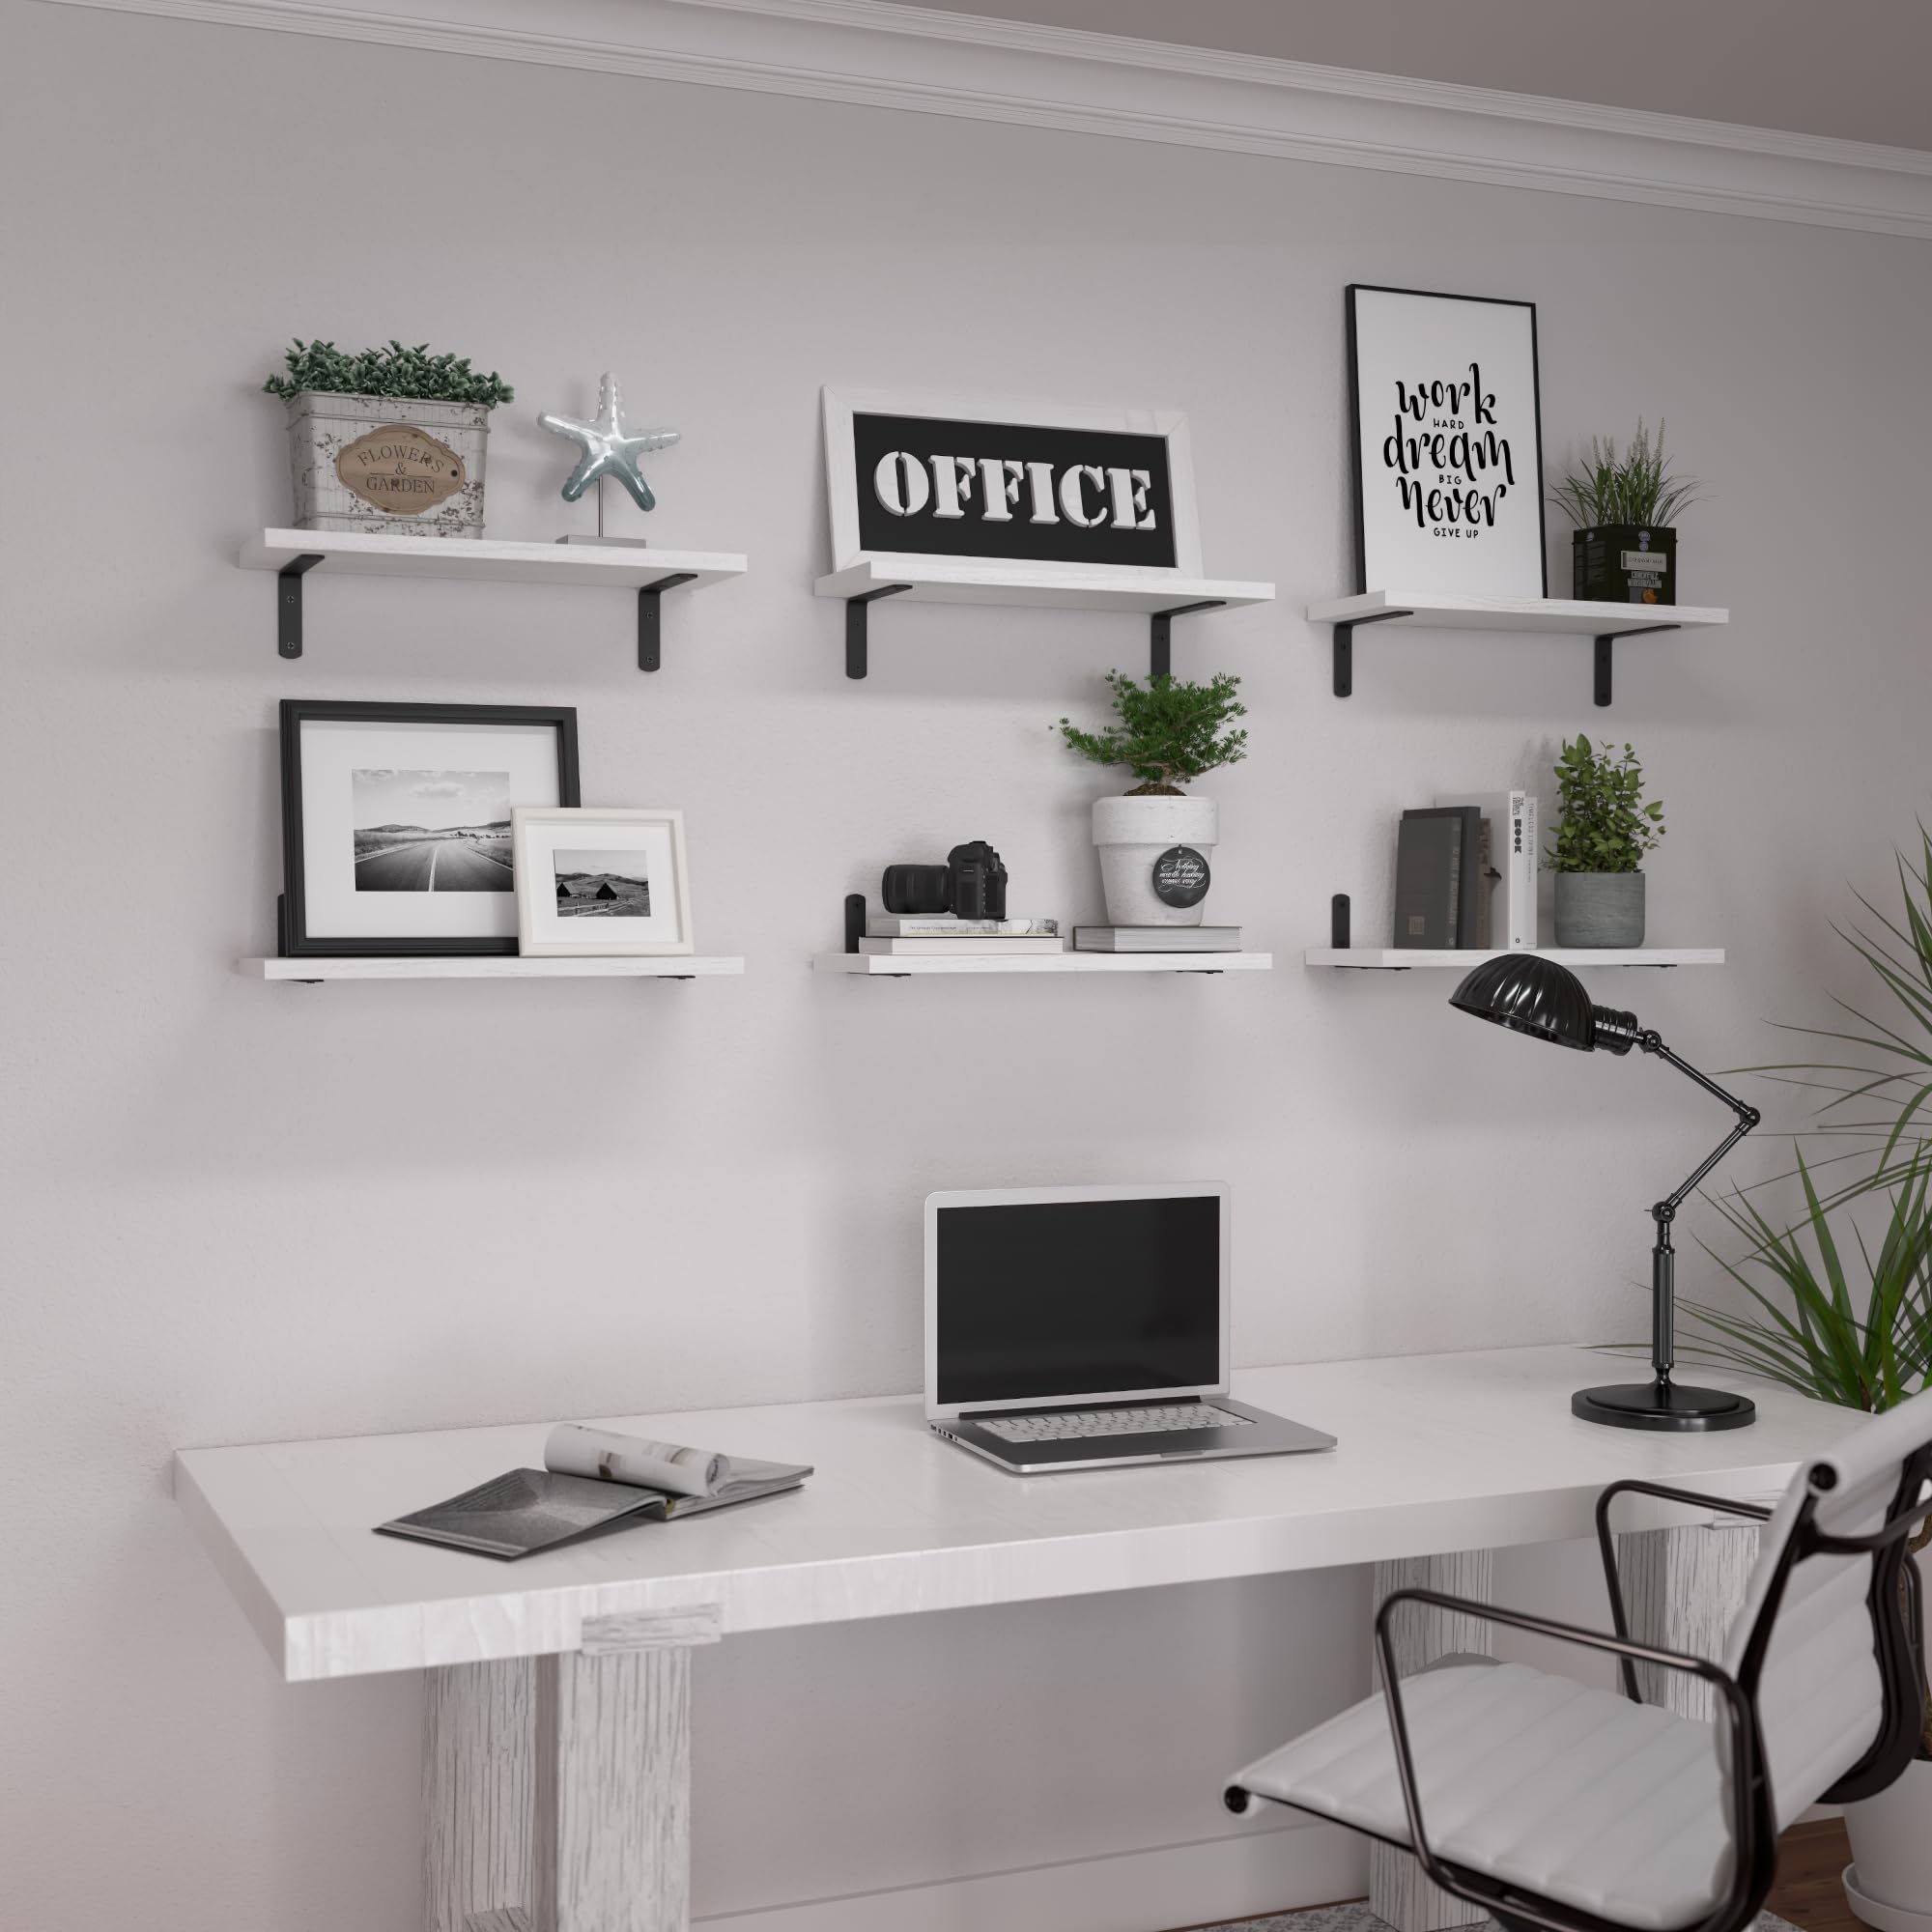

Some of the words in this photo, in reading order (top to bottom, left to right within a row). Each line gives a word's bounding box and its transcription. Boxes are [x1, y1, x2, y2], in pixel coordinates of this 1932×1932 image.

[1395, 362, 1498, 425] work
[1433, 418, 1464, 429] HARD
[1383, 413, 1516, 486] dream
[357, 445, 444, 473] FLOWERS
[395, 462, 408, 476] &
[366, 476, 435, 494] GARDEN
[1438, 474, 1463, 484] BIG
[873, 450, 1156, 530] OFFICE
[1433, 526, 1461, 539] GIVE
[1465, 529, 1480, 540] UP
